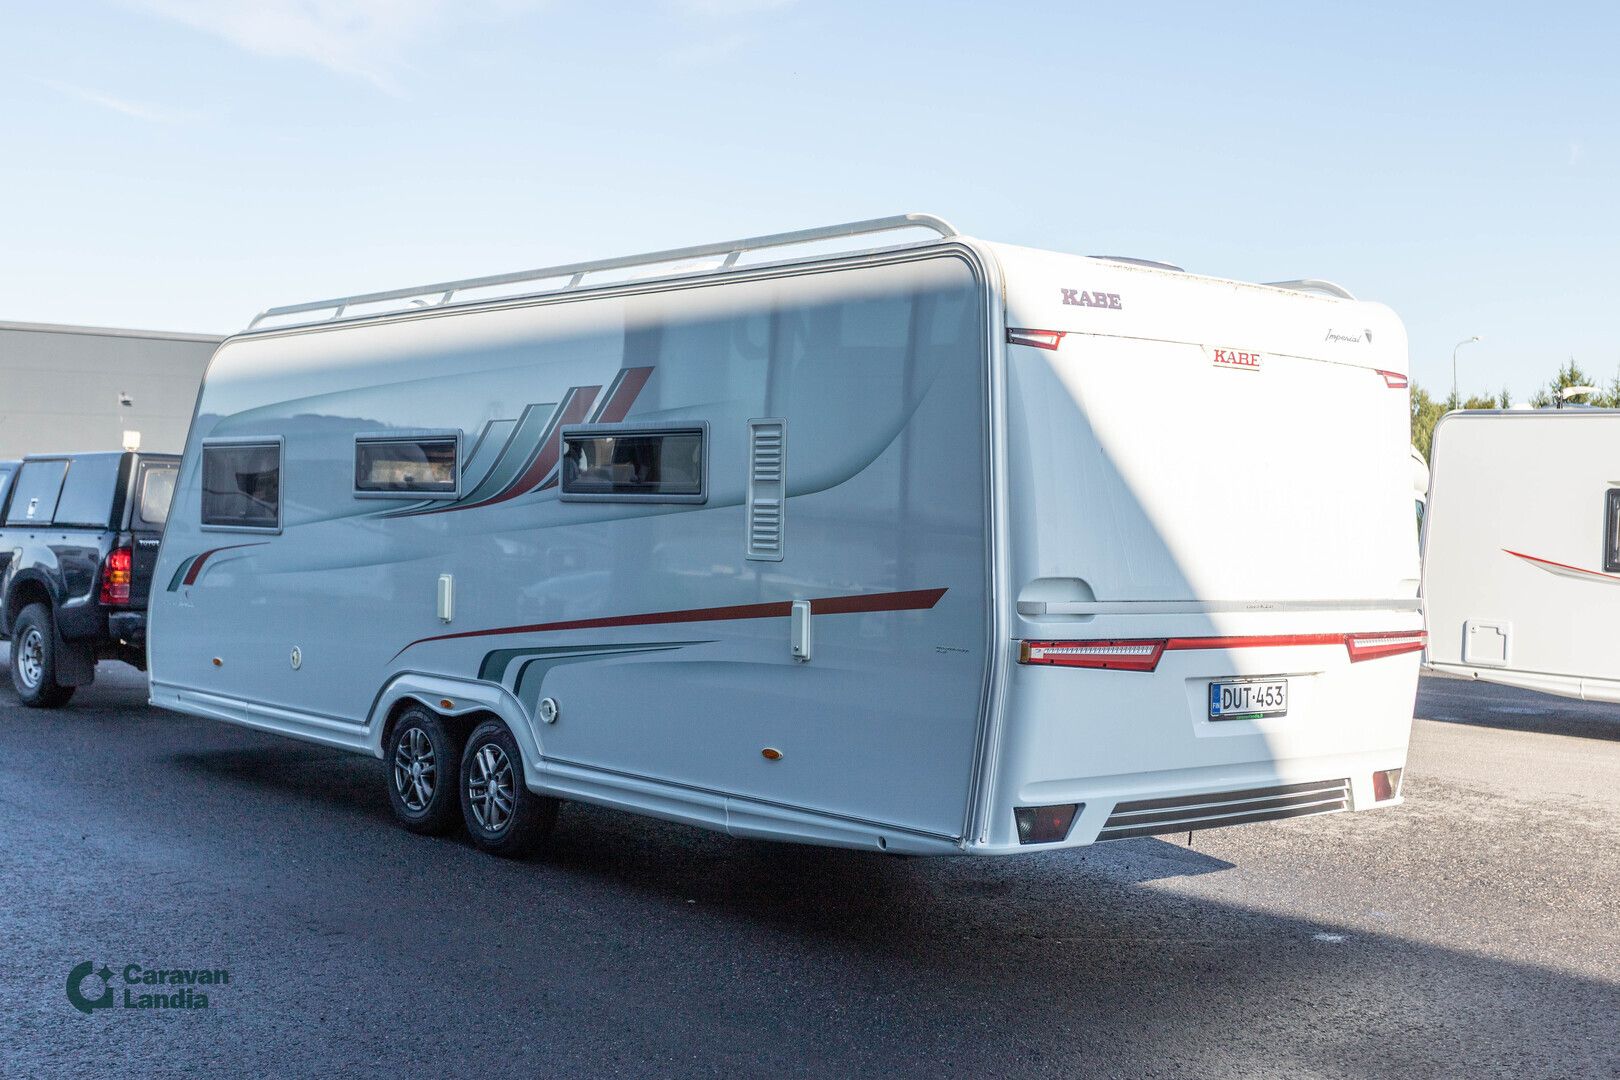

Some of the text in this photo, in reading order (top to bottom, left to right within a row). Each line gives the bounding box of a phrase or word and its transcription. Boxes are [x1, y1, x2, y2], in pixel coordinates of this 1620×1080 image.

[1061, 288, 1122, 310] KABE
[1213, 349, 1260, 366] KABE
[1223, 686, 1283, 709] DUT-453
